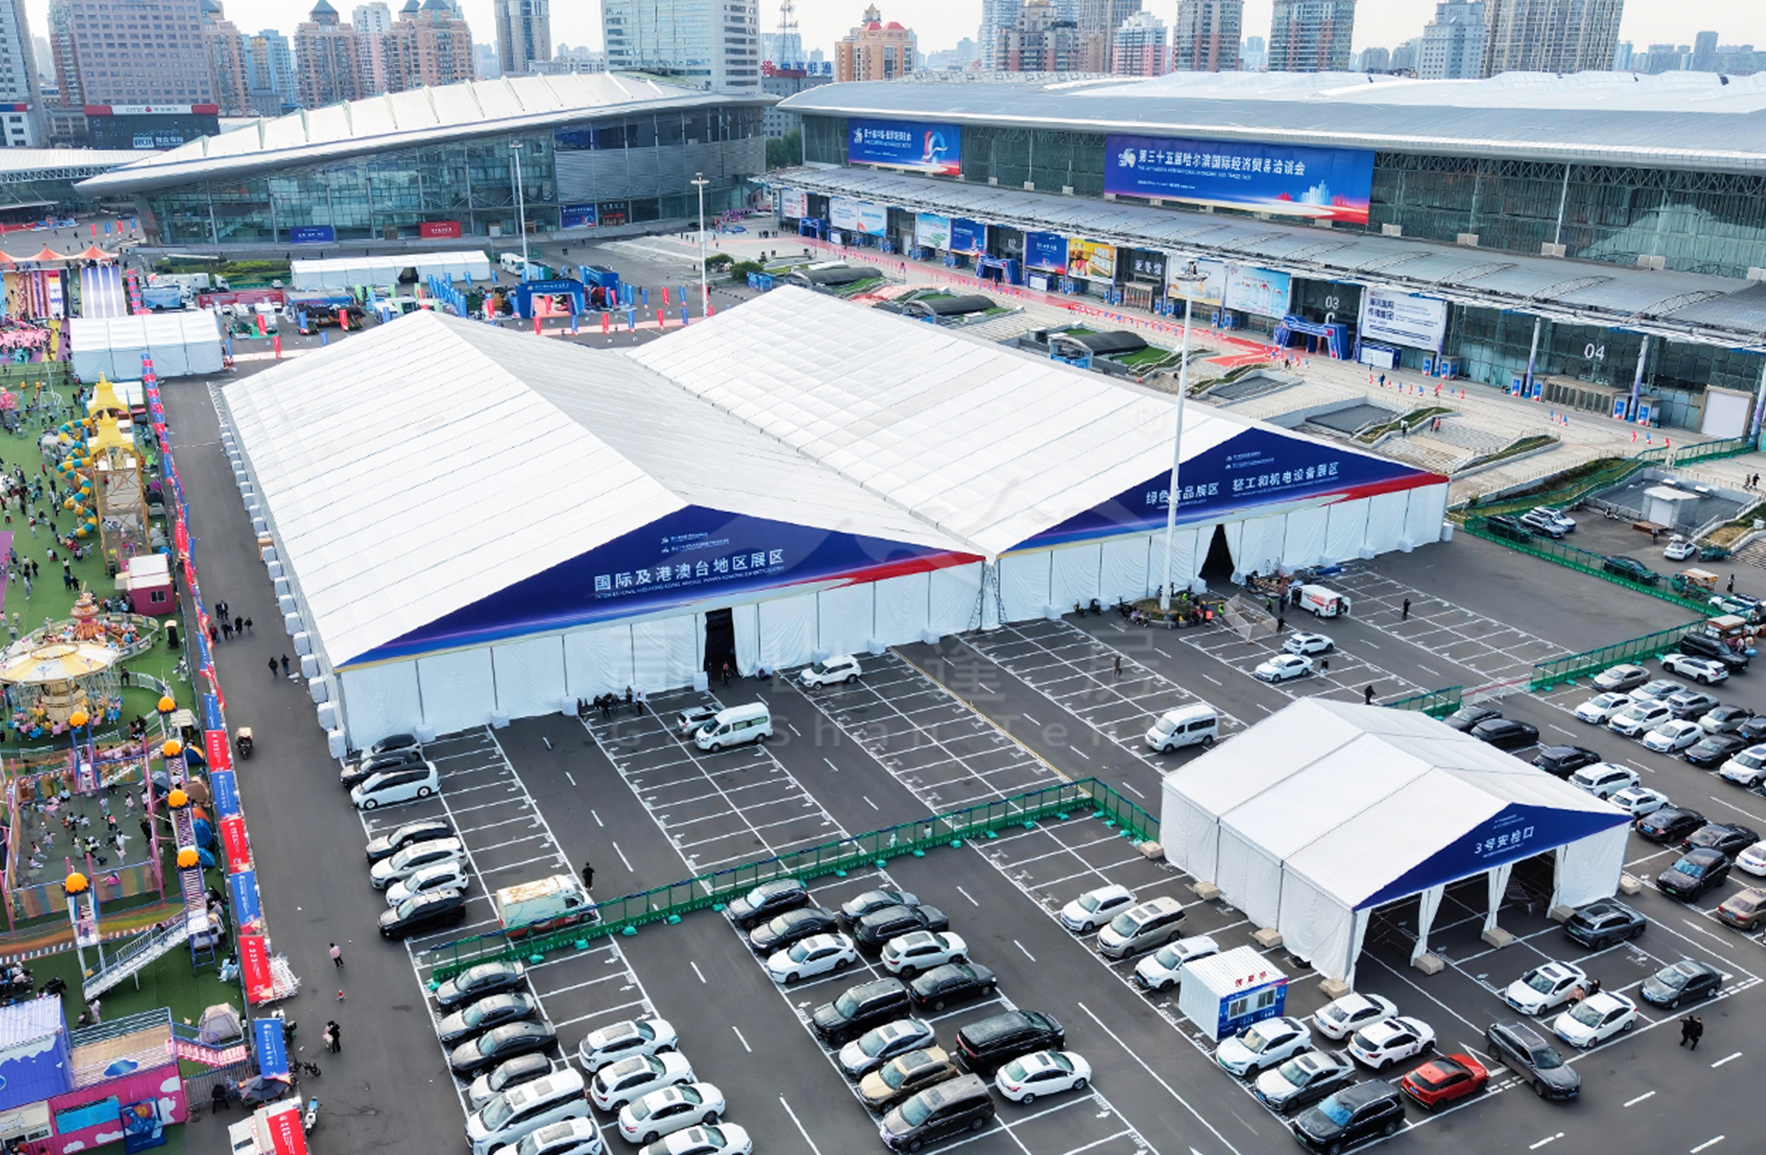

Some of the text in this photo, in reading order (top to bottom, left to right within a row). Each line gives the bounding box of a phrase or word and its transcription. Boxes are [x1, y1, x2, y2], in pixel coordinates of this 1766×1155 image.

[1325, 295, 1340, 310] 03
[1584, 343, 1605, 360] 04
[1232, 461, 1340, 492] 轻工和机电设备展区
[594, 549, 784, 592] 国际及港澳台地区展区
[1474, 826, 1535, 854] 3号安检口
